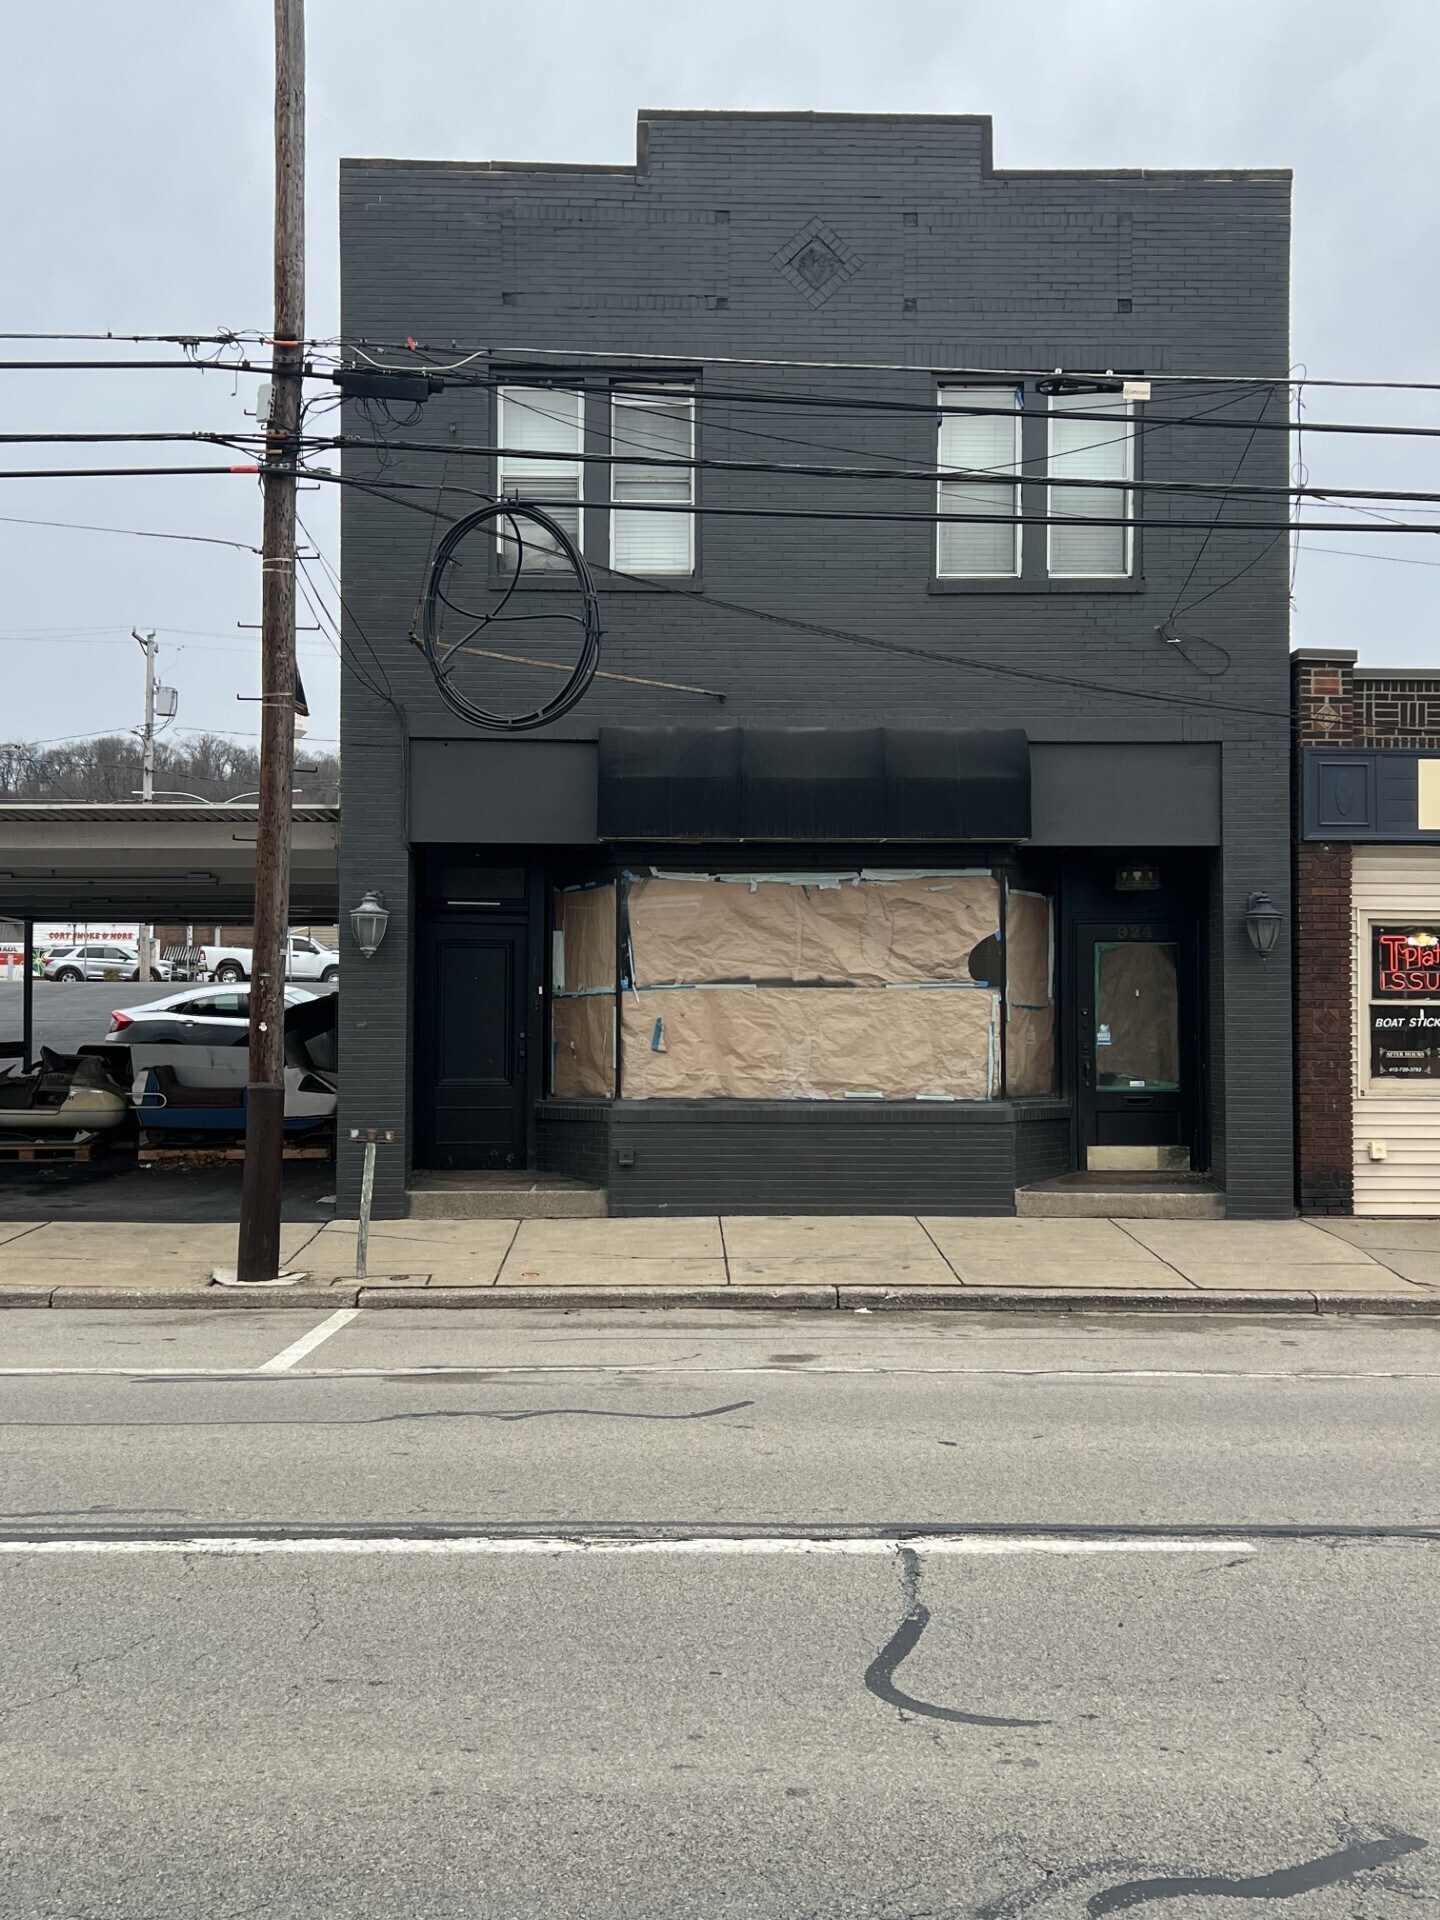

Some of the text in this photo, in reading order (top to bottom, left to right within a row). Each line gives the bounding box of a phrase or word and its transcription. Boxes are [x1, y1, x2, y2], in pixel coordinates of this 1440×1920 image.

[110, 932, 133, 940] MORE
[1381, 972, 1440, 990] ISSU
[1375, 1018, 1406, 1028] BOAT
